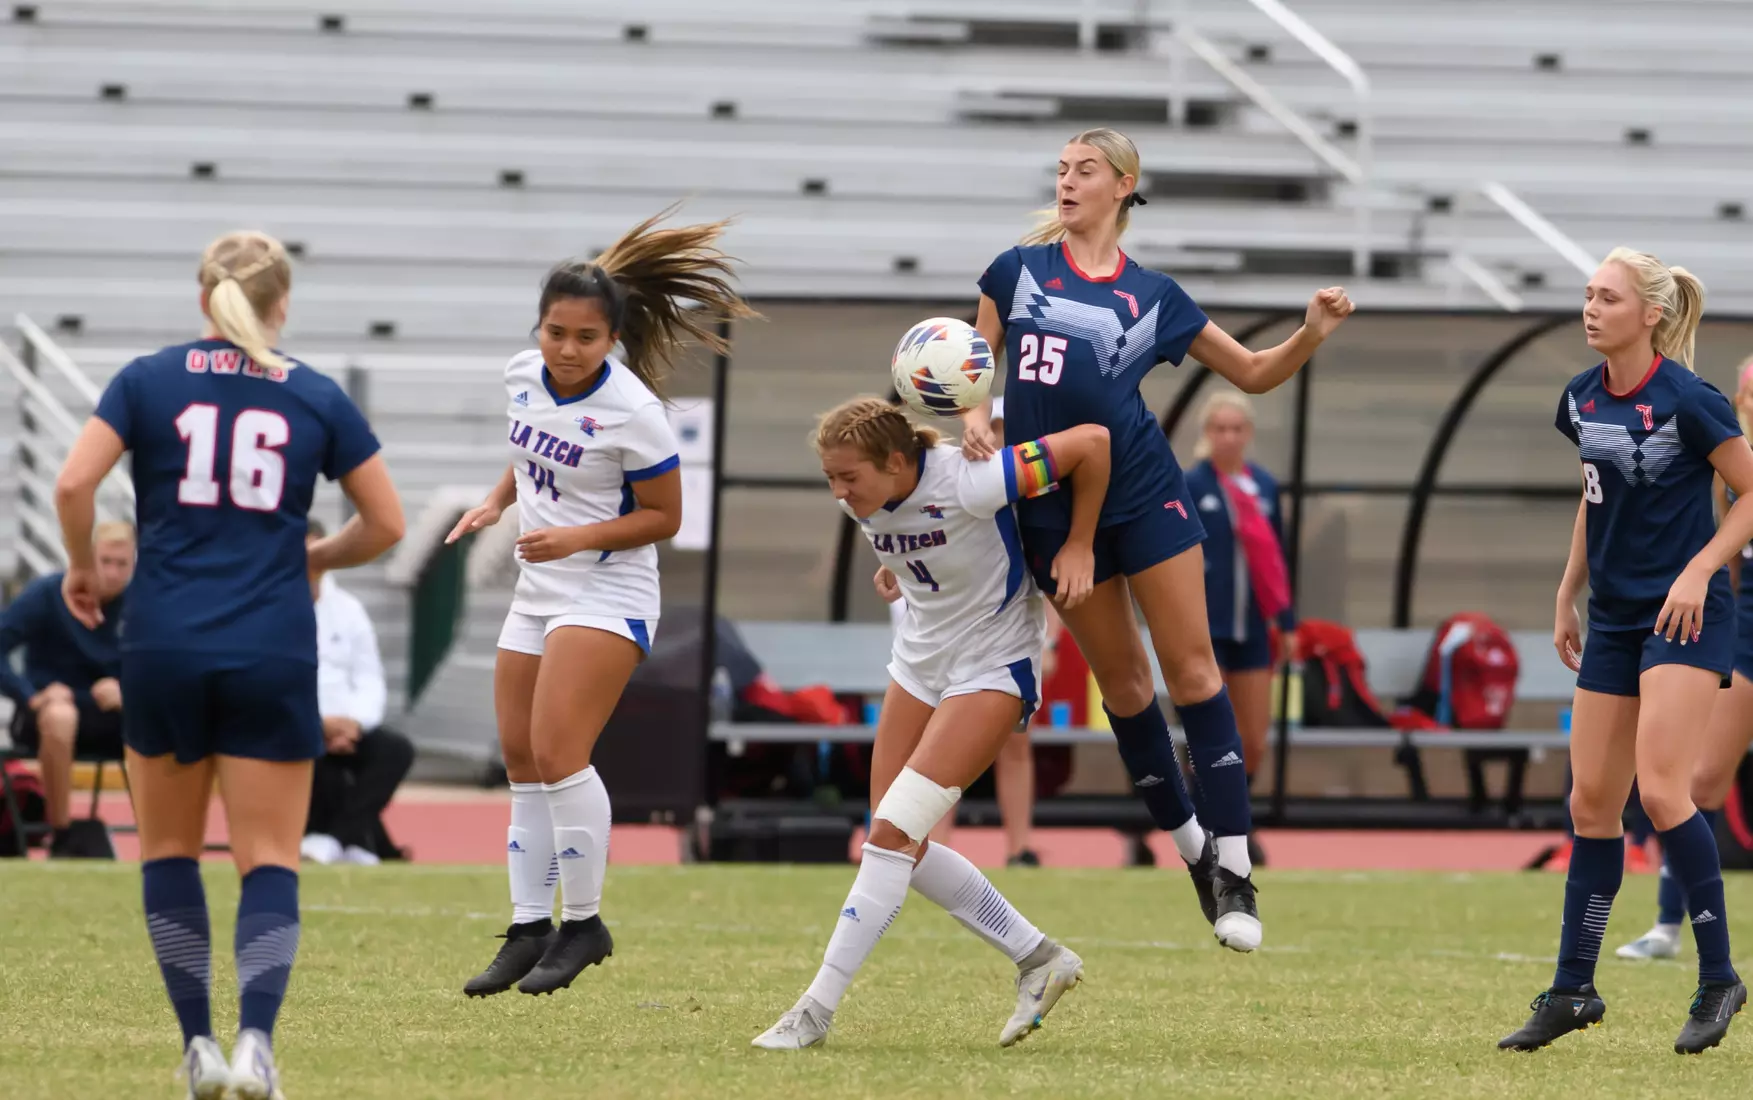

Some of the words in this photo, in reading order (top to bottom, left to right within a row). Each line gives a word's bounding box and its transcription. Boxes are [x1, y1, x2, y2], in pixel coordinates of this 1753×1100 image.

[1018, 333, 1068, 386] 25
[174, 401, 290, 513] 16
[509, 420, 533, 449] LA
[533, 430, 585, 468] TECH
[873, 533, 894, 554] LA
[897, 529, 947, 554] TECH
[906, 559, 940, 592] 4
